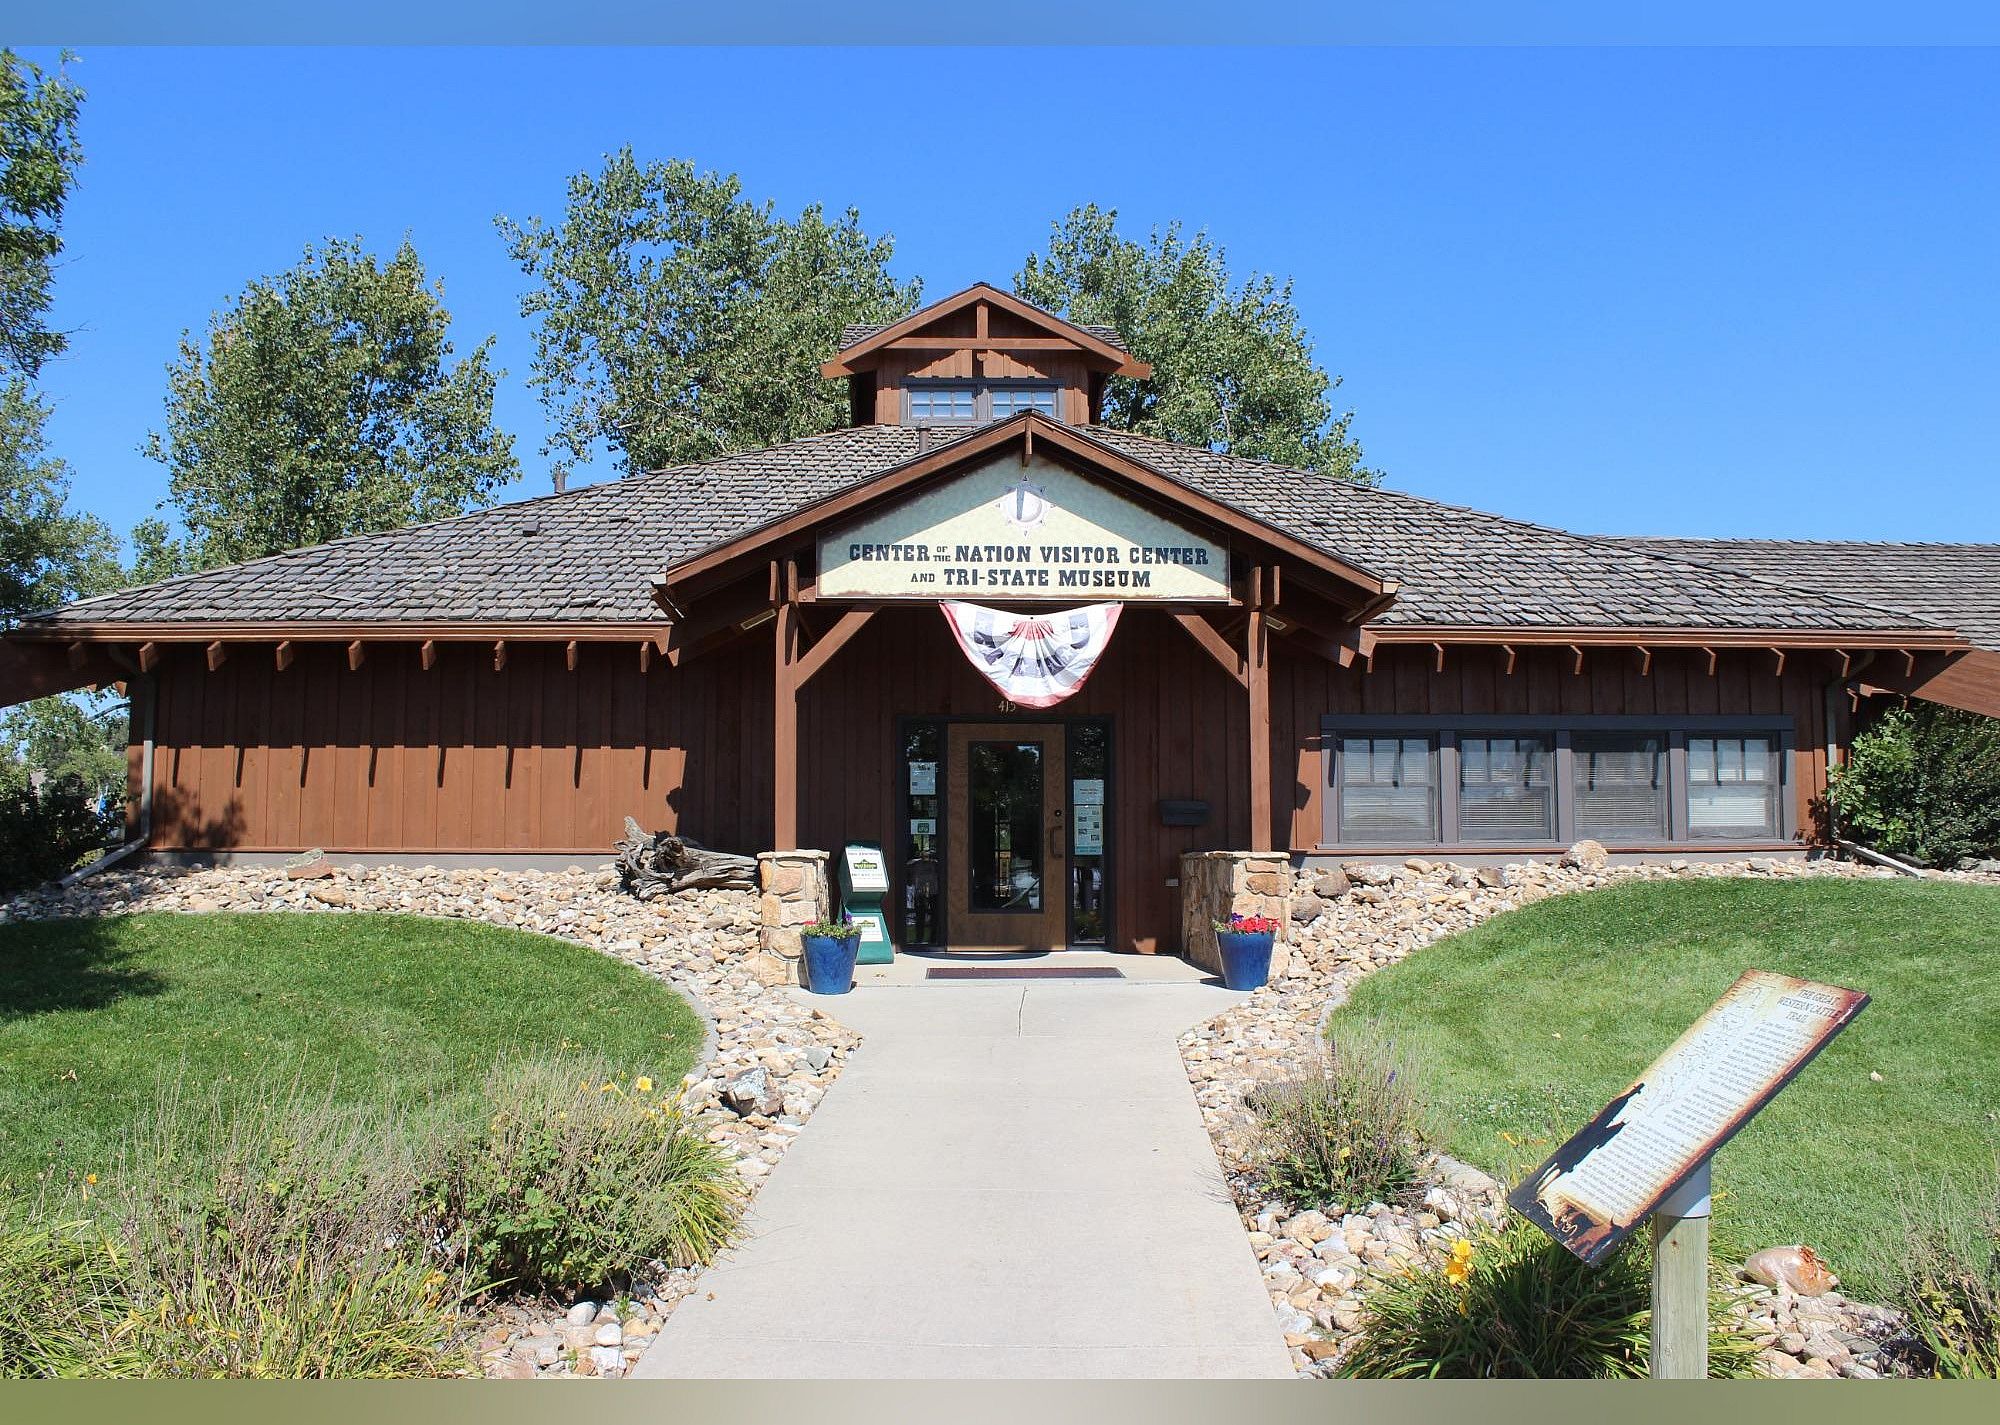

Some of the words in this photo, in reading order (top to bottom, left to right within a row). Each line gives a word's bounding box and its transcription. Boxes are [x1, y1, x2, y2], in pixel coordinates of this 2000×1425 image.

[849, 544, 931, 562] CENTER
[955, 545, 1031, 563] NATION
[1039, 546, 1120, 564] VISITOR
[1129, 547, 1209, 565] CENTER
[910, 573, 935, 583] AND
[943, 568, 1049, 587] TRI-STATE
[1058, 570, 1151, 588] MUSEUM
